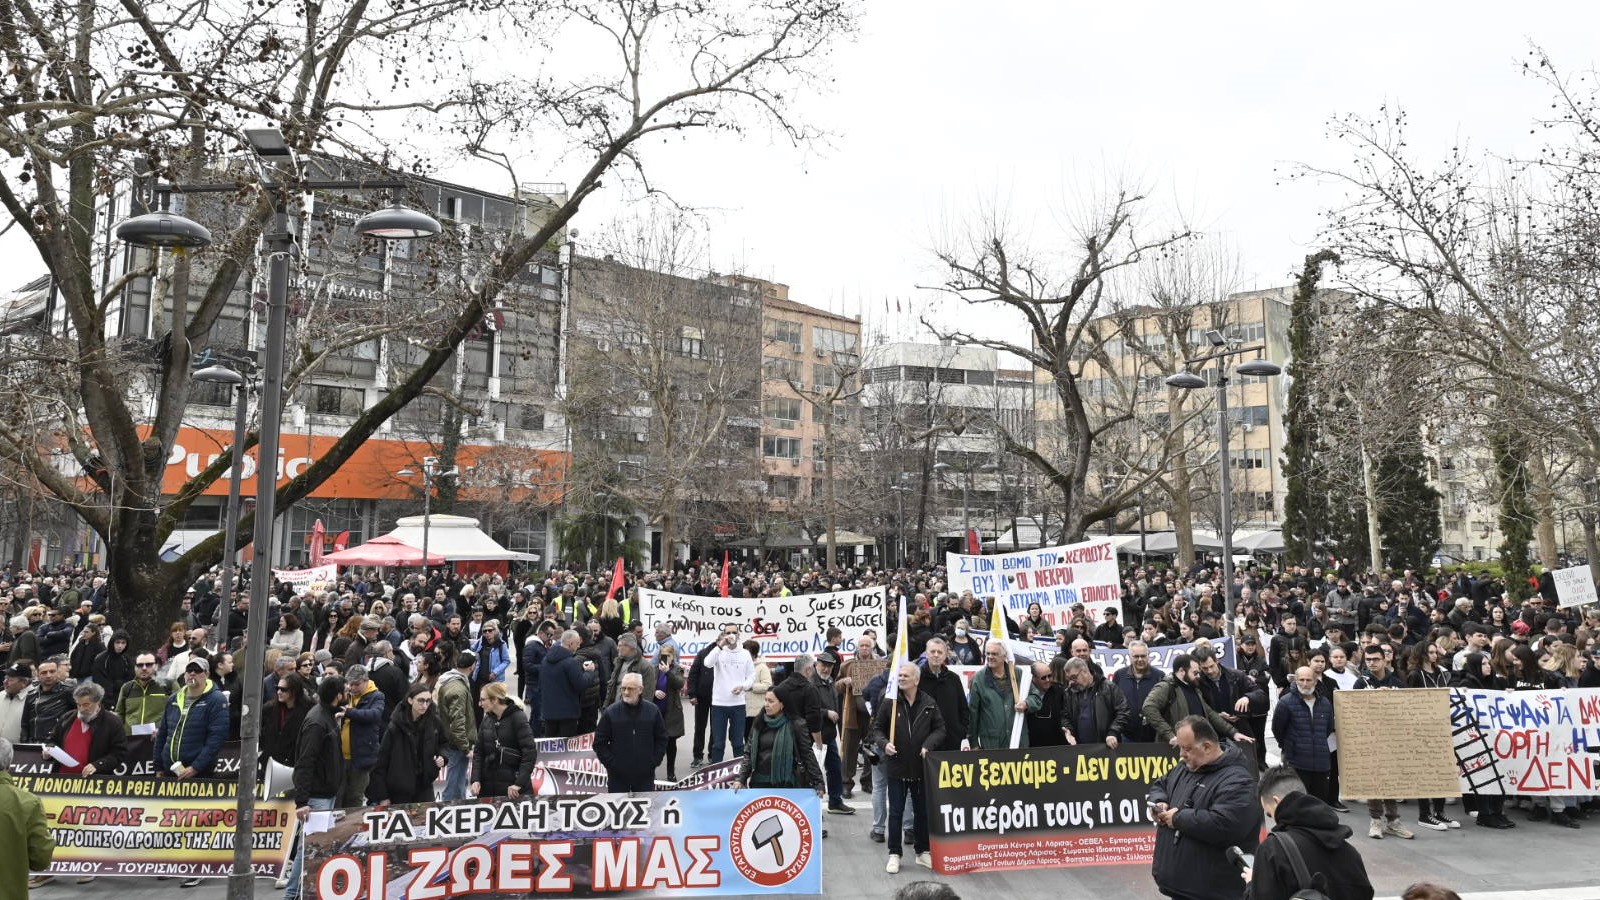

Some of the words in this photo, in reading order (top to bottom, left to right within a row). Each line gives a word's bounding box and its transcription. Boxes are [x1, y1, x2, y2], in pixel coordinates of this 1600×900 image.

[960, 556, 995, 573] ΣΤΟΝ
[1002, 556, 1032, 570] ΒΩΜΟ
[1037, 552, 1058, 568] ΤΟΥ
[1015, 572, 1029, 590] ΟΙ
[1035, 567, 1074, 588] ΝΕΚΡΟΙ
[647, 594, 665, 609] Τα
[672, 597, 705, 616] κέρδη
[710, 605, 742, 617] τους
[757, 600, 766, 615] ή
[780, 604, 794, 614] οι
[806, 594, 844, 617] ζωές
[851, 591, 881, 612] μας
[787, 617, 808, 633] θα
[1550, 696, 1573, 725] ΤΑ
[1494, 729, 1549, 759] ΟΡΓΗ
[1572, 728, 1588, 753] Η
[938, 760, 974, 789] Δεν
[978, 753, 1058, 791] ξεχνάμε
[1076, 754, 1110, 782] Δεν
[1517, 756, 1591, 791] ΔΕΝ
[33, 777, 103, 795] ΜΟΝΟΜΙΑΣ
[106, 779, 123, 795] ΘΑ
[126, 780, 155, 796] ΡΘΕΙ
[157, 781, 214, 797] ΑΝΑΠΟΔΑ
[217, 783, 225, 797] Ο
[58, 805, 145, 826] ΑΓΩΝΑΣ
[160, 808, 277, 828] ΣΥΓΚΡΟΣΗ
[365, 812, 413, 842] ΤΑ
[427, 803, 547, 836] ΚΕΡΔΗ
[560, 800, 649, 828] ΤΟΥΣ
[662, 799, 680, 825] ή
[774, 799, 806, 827] ΚΕΝΤΡΟ
[940, 803, 966, 833] Τα
[972, 798, 1039, 834] κέρδη
[1043, 799, 1094, 829] τους
[1100, 793, 1113, 824] ή
[1119, 798, 1140, 824] οι
[113, 830, 125, 849] Ο
[125, 831, 182, 850] ΔΡΟΜΟΣ
[185, 832, 212, 850] ΤΗΣ
[117, 862, 199, 874] ΤΟΥΡΙΣΜΟΥ
[200, 863, 214, 874] Ν.
[316, 852, 388, 900] ΟΙ
[406, 841, 575, 899] ΖΩΕΣ
[593, 835, 721, 892] ΜΑΣ
[784, 841, 810, 879] ΛΑΡΙΣΑΣ
